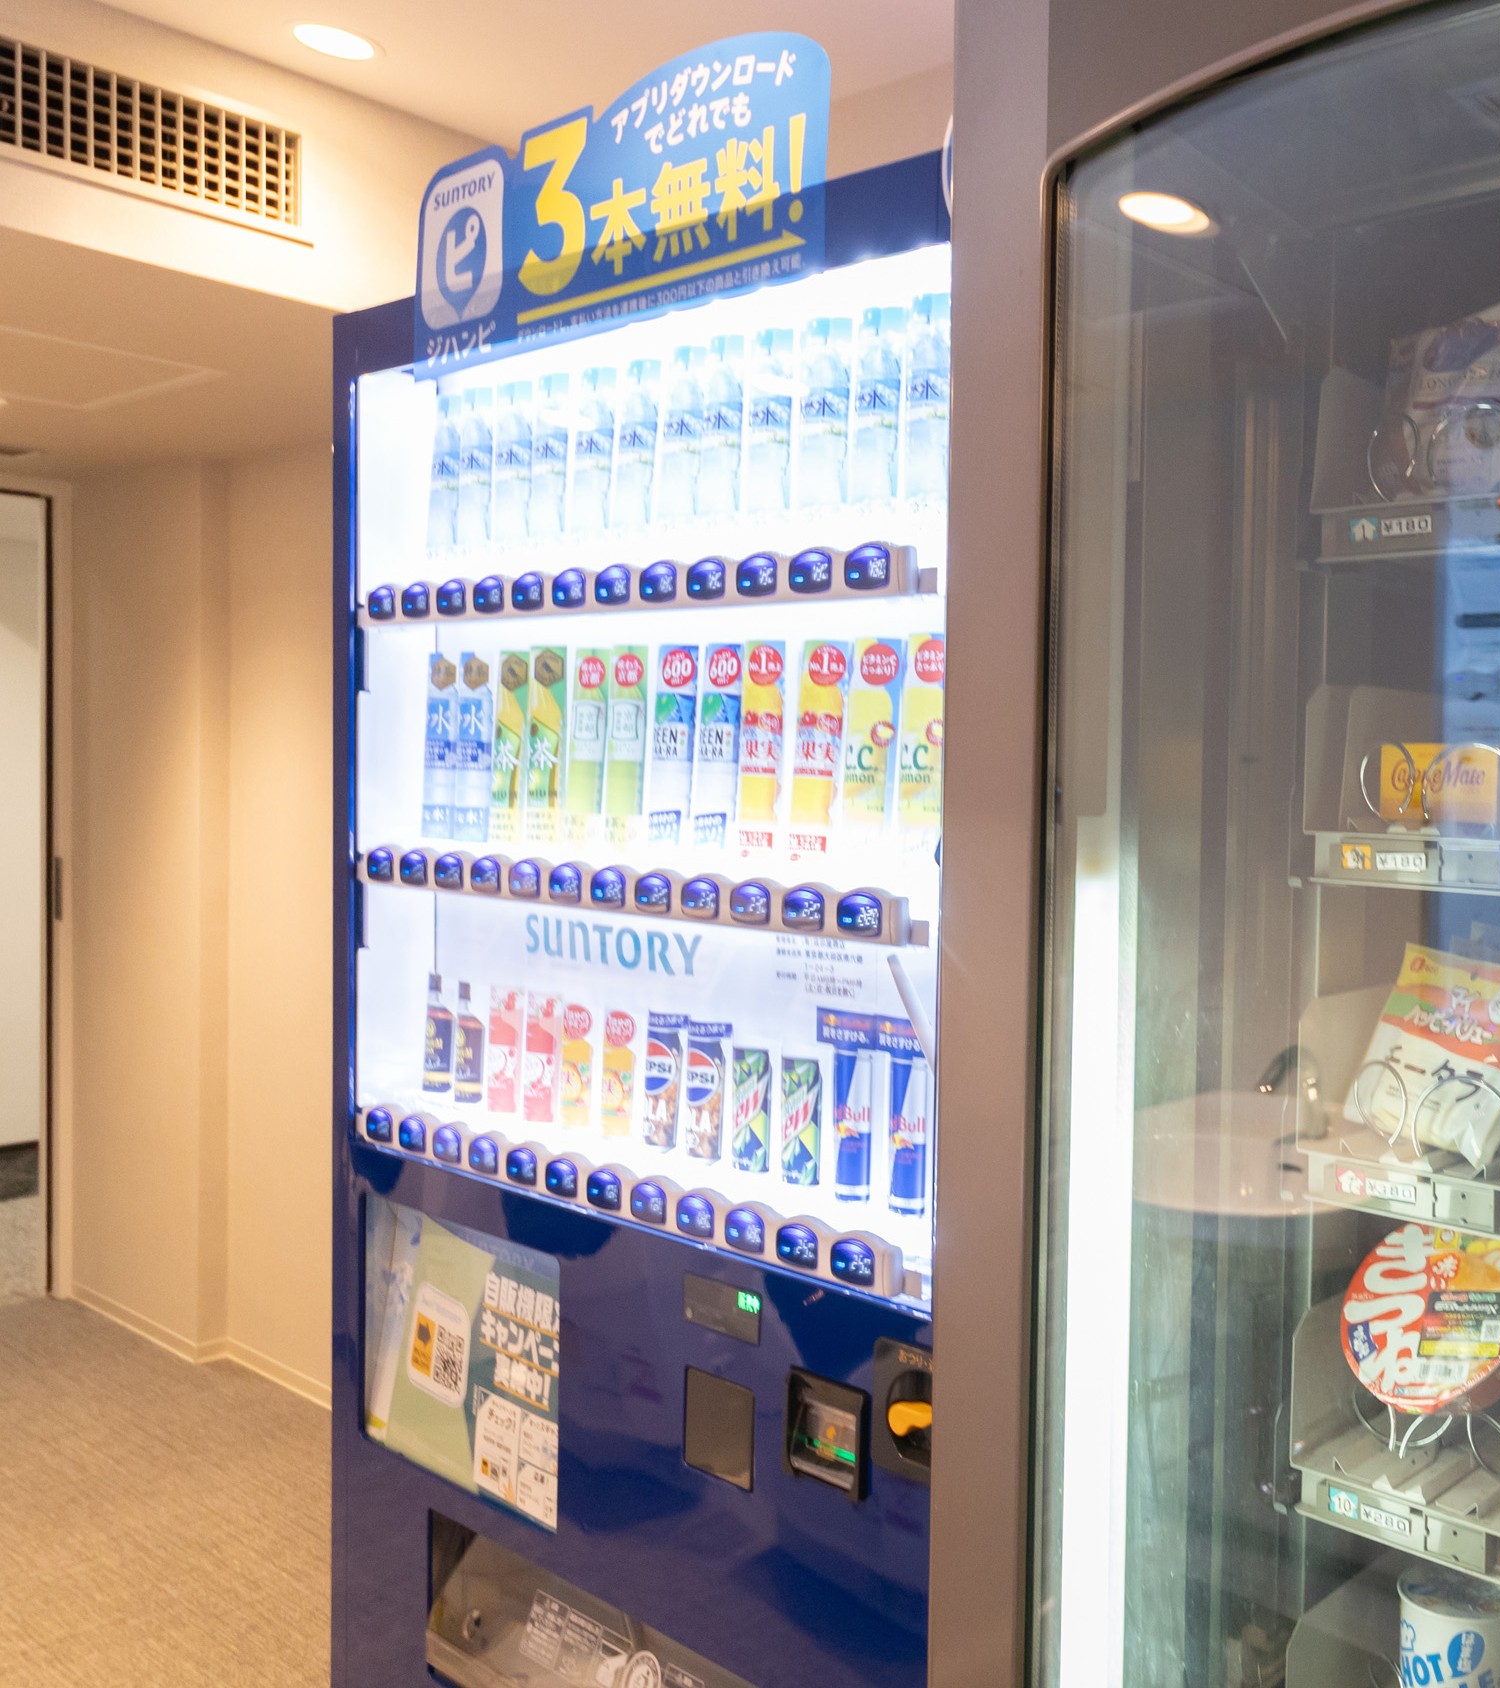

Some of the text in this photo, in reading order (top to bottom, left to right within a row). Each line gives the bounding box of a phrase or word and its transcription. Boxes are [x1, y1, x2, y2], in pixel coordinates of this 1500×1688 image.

[610, 49, 797, 145] アプリダウンロード
[645, 92, 752, 154] でどれでも
[433, 171, 495, 212] SUNTORY
[426, 320, 496, 368] ジハンピ
[663, 658, 693, 679] 600
[709, 657, 739, 679] 600
[525, 911, 703, 977] SUNTORY
[687, 1069, 715, 1086] EPSI
[1343, 1223, 1438, 1394] きつね
[1337, 1496, 1407, 1532] 10 ¥280
